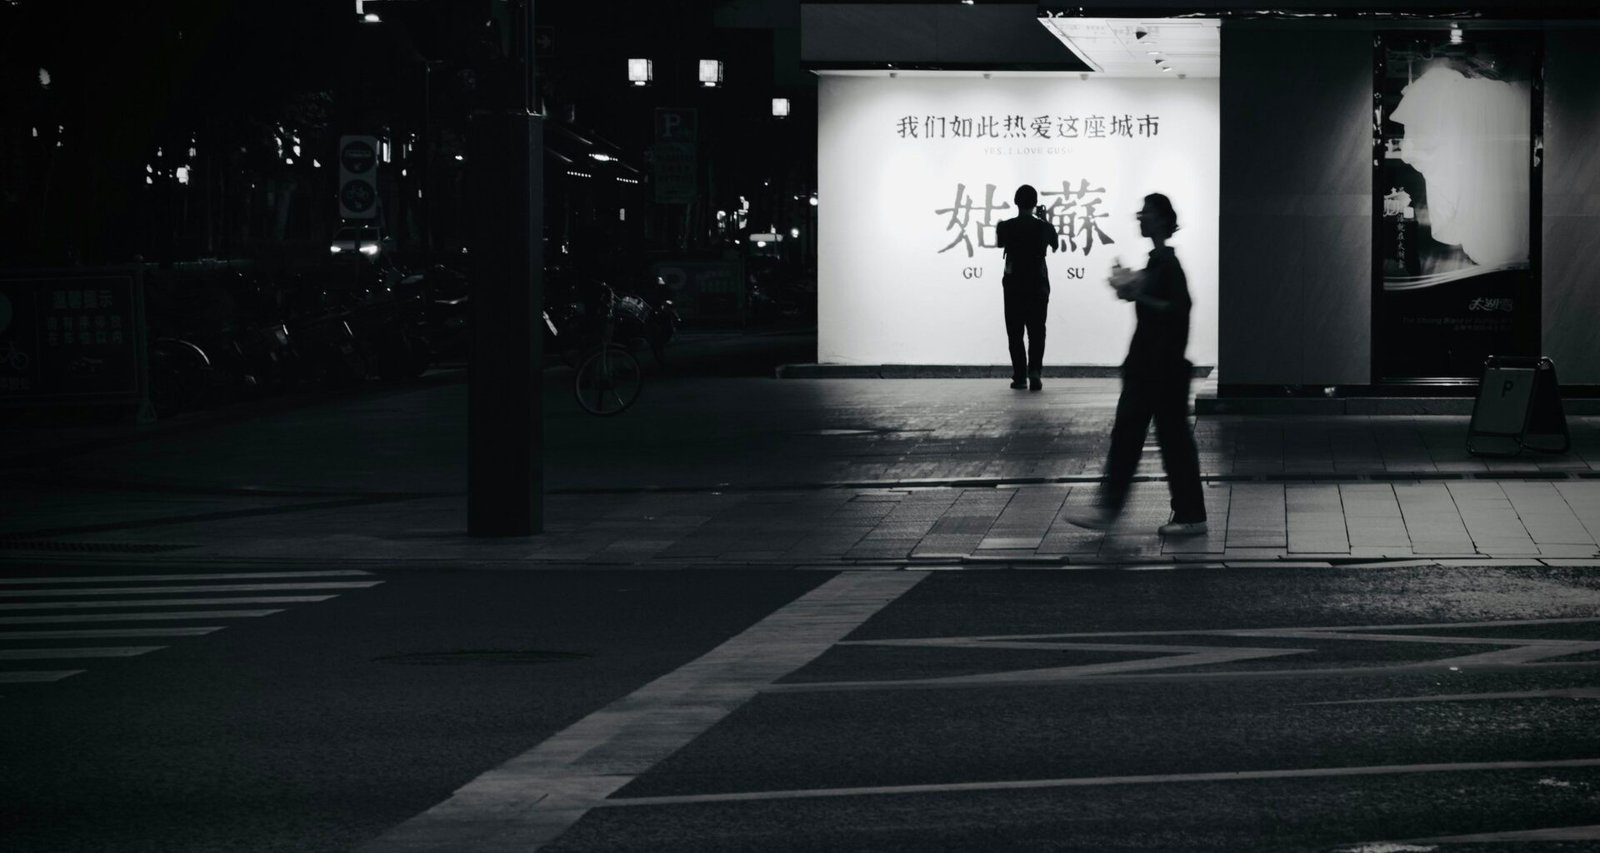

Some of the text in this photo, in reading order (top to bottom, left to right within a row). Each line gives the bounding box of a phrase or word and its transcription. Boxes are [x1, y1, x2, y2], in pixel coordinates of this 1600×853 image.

[662, 113, 681, 137] P
[896, 114, 1160, 139] 我们如此热爱这座城市
[1016, 147, 1042, 156] LOVE
[962, 267, 1086, 280] GU SU
[1501, 380, 1514, 398] P
